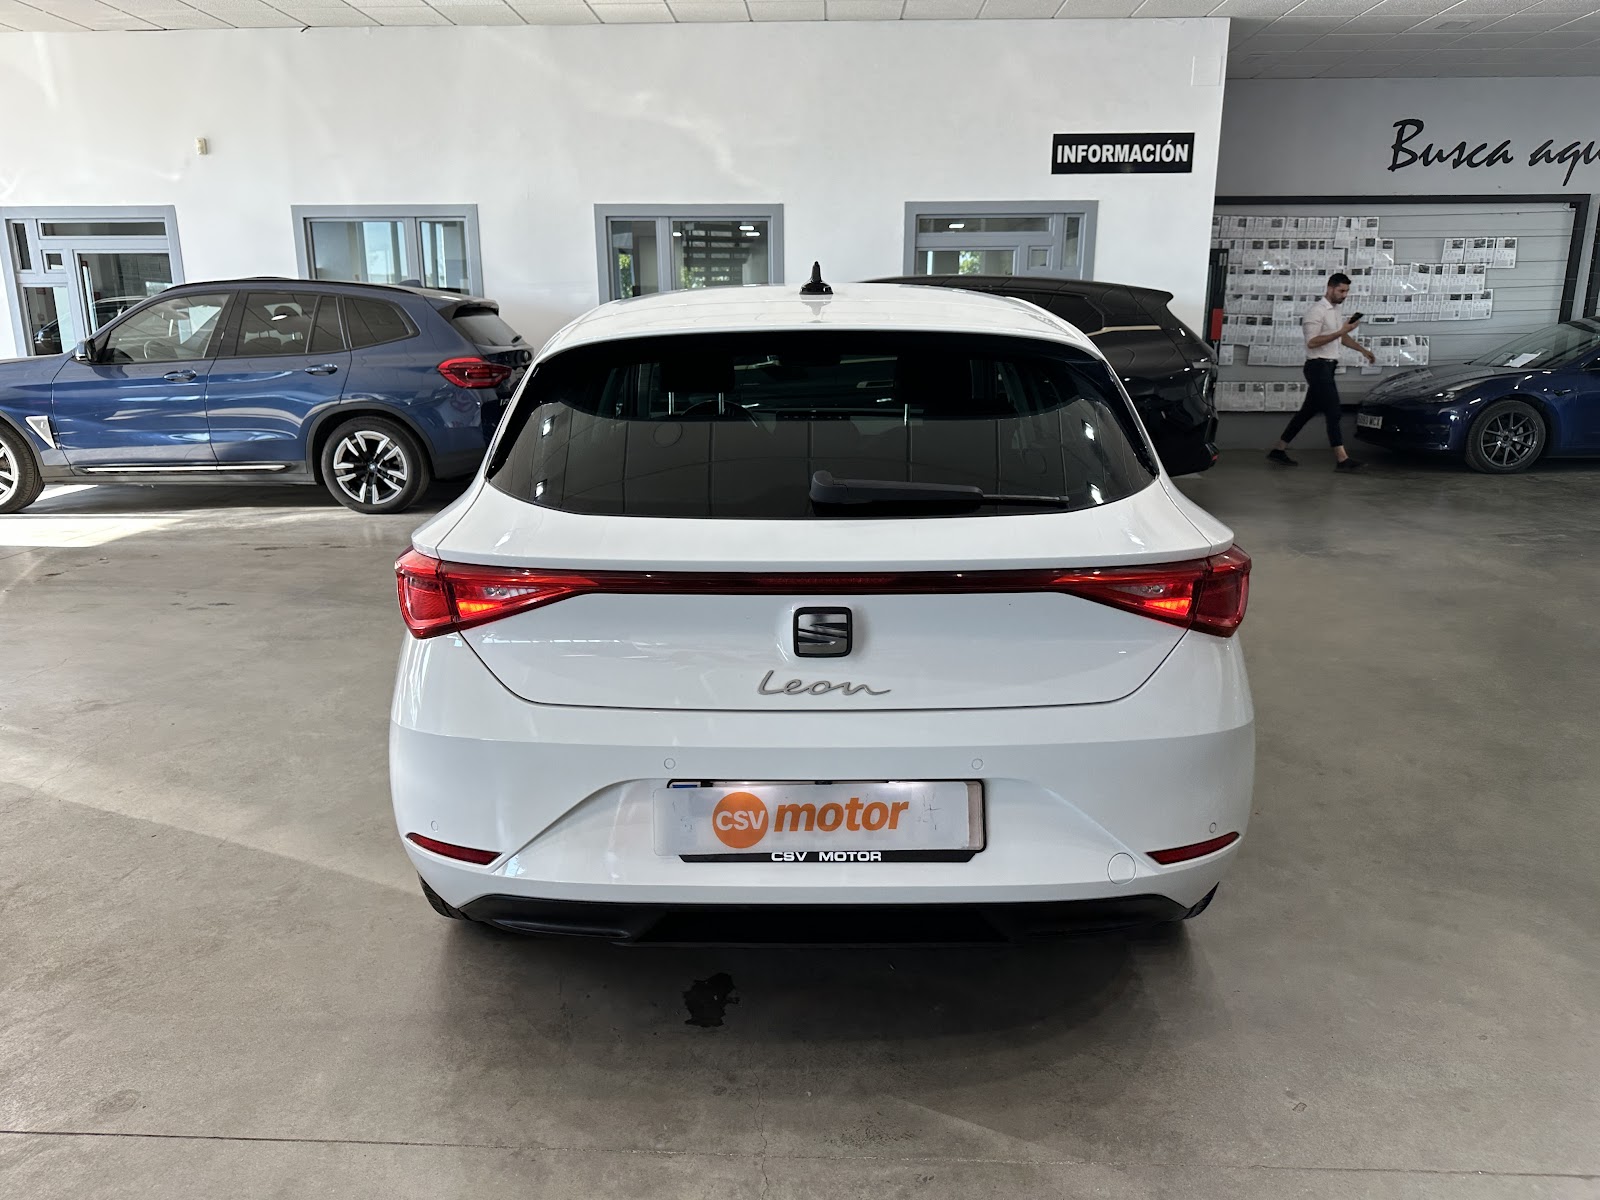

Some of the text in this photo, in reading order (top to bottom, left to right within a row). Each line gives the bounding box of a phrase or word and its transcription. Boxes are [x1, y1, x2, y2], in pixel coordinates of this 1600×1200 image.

[1056, 139, 1189, 163] INFORMACIÓN
[1387, 118, 1514, 172] Busca
[757, 670, 891, 696] Leon
[715, 797, 910, 832] CSV motor
[771, 851, 882, 862] CSV MOTOR
